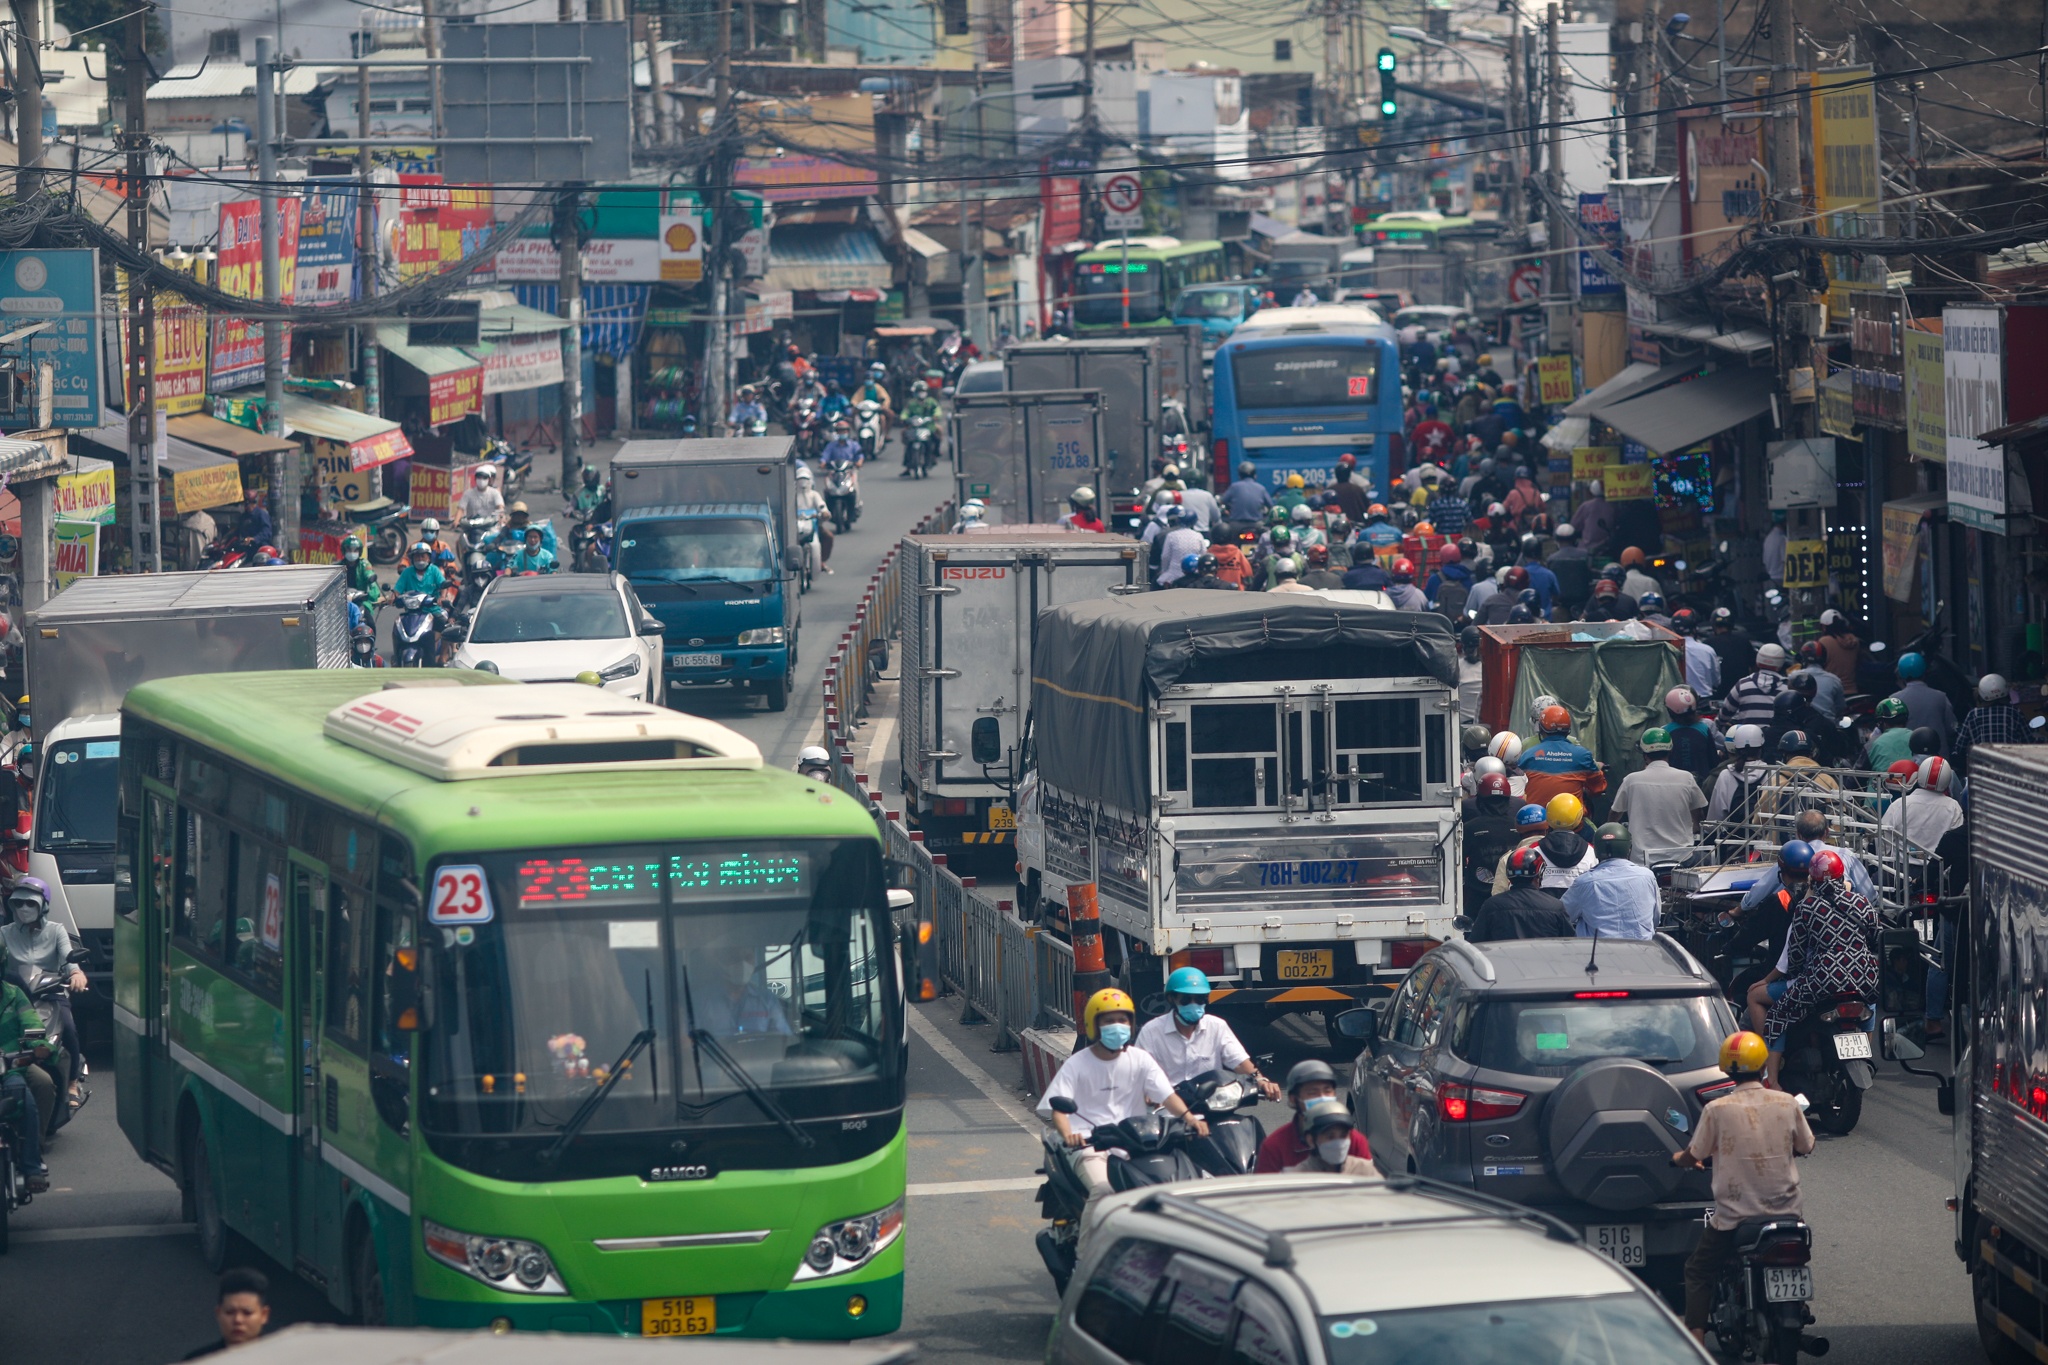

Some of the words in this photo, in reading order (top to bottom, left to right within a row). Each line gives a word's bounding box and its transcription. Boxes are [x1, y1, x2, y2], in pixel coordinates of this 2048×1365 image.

[1349, 377, 1368, 396] 27
[1057, 441, 1080, 455] 51C
[318, 453, 350, 474] BÌN
[1050, 455, 1090, 469] 702.88
[56, 536, 88, 573] MÍA
[1785, 546, 1826, 583] DÉP
[943, 567, 1005, 579] ISUZU
[1546, 750, 1573, 758] AhaMove
[1259, 861, 1359, 886] 78H-002.27
[438, 873, 483, 915] 23
[265, 885, 280, 940] 23
[1293, 952, 1318, 964] 78H
[1284, 964, 1327, 978] 002.27
[1840, 1045, 1869, 1058] 422.53
[651, 1165, 707, 1180] SAMCO
[1599, 1227, 1630, 1245] 51G
[1773, 1283, 1806, 1297] 2726
[663, 1301, 694, 1317] 51B
[650, 1317, 707, 1335] 303.63
